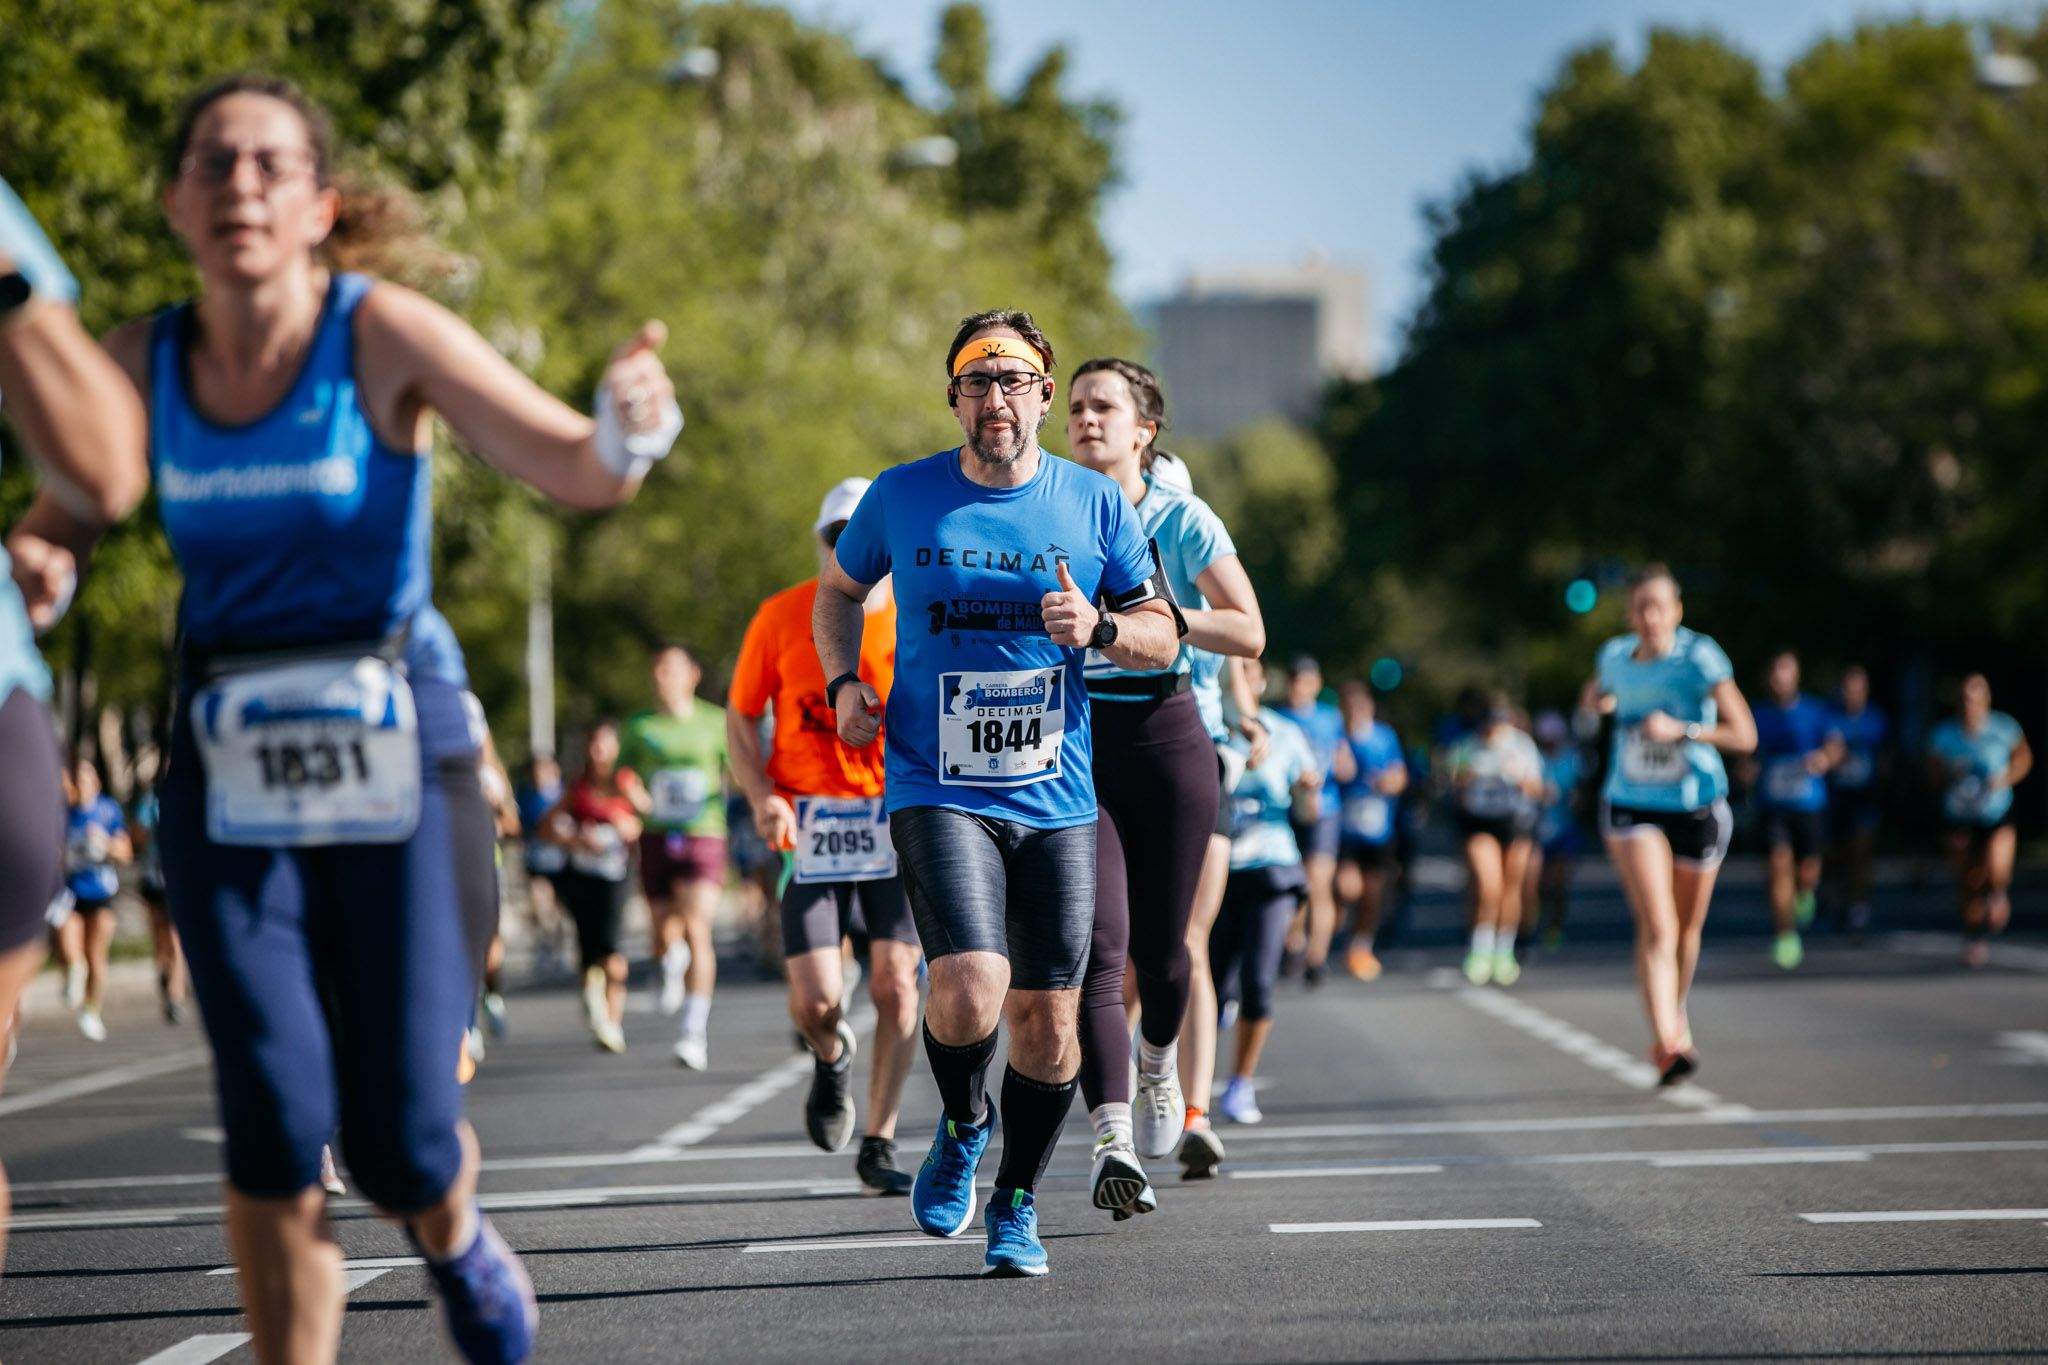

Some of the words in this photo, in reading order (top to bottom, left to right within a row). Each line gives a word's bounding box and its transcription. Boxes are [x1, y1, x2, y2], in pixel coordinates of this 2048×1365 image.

[957, 600, 1043, 616] BOMBER
[1015, 615, 1045, 631] MAD
[984, 685, 1044, 698] BOMBEROS
[977, 704, 1042, 717] DECIMAS
[966, 717, 1042, 754] 1844
[255, 741, 369, 790] 1831
[812, 830, 876, 857] 2095
